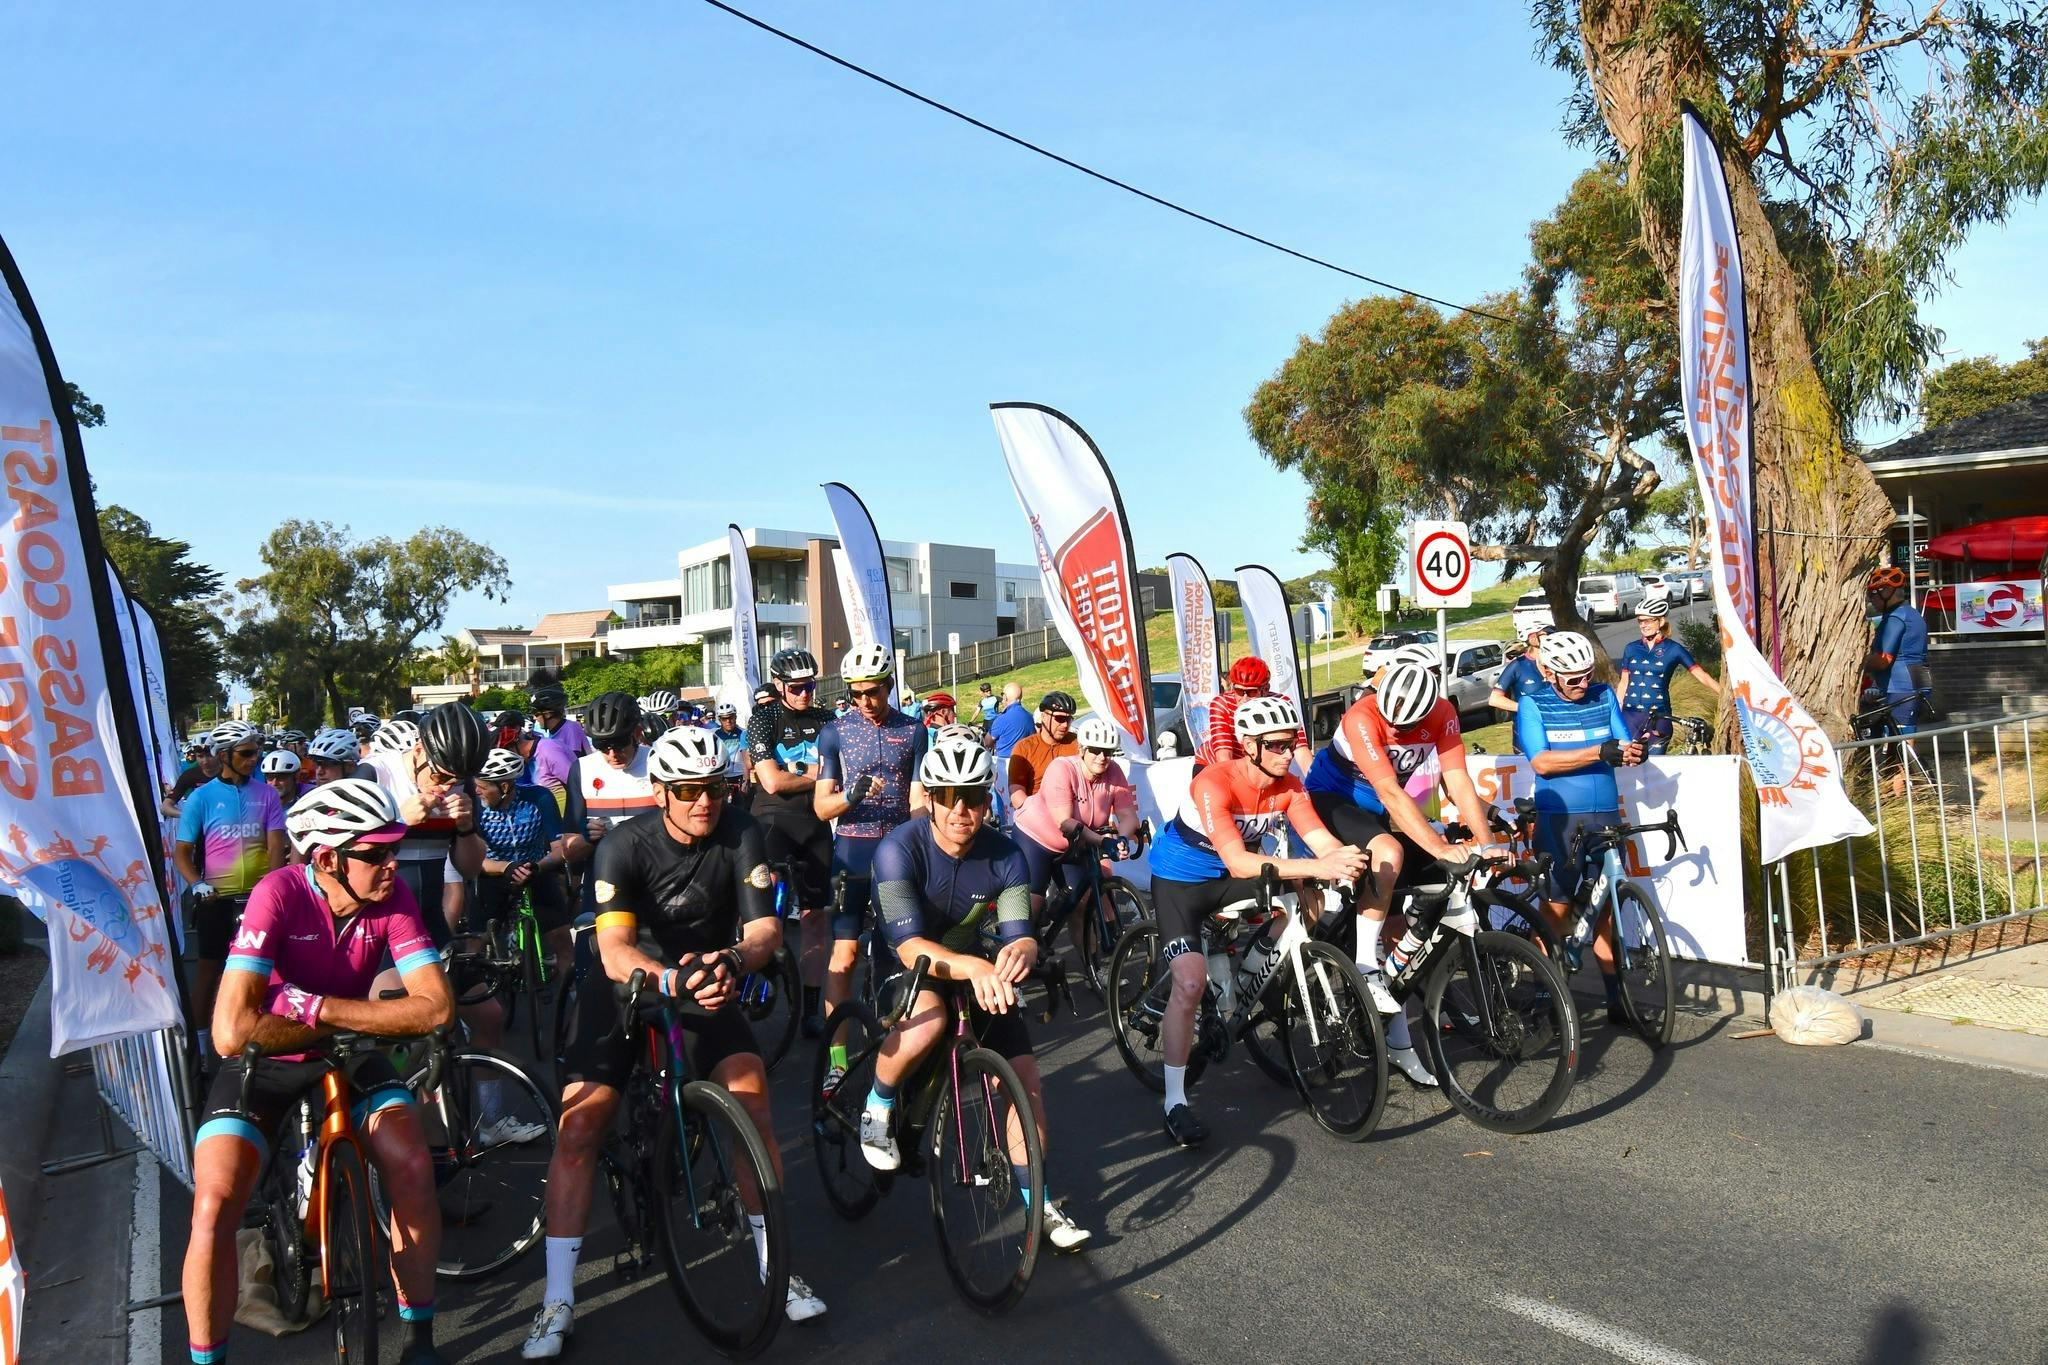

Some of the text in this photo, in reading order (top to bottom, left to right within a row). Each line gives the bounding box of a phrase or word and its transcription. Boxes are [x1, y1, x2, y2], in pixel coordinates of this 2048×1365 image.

[1426, 550, 1461, 578] 40
[1358, 722, 1380, 761] JAKROO
[696, 756, 717, 768] 306
[1203, 791, 1214, 834] JAKROO
[1163, 937, 1191, 962] RCA
[1397, 925, 1444, 986] REK
